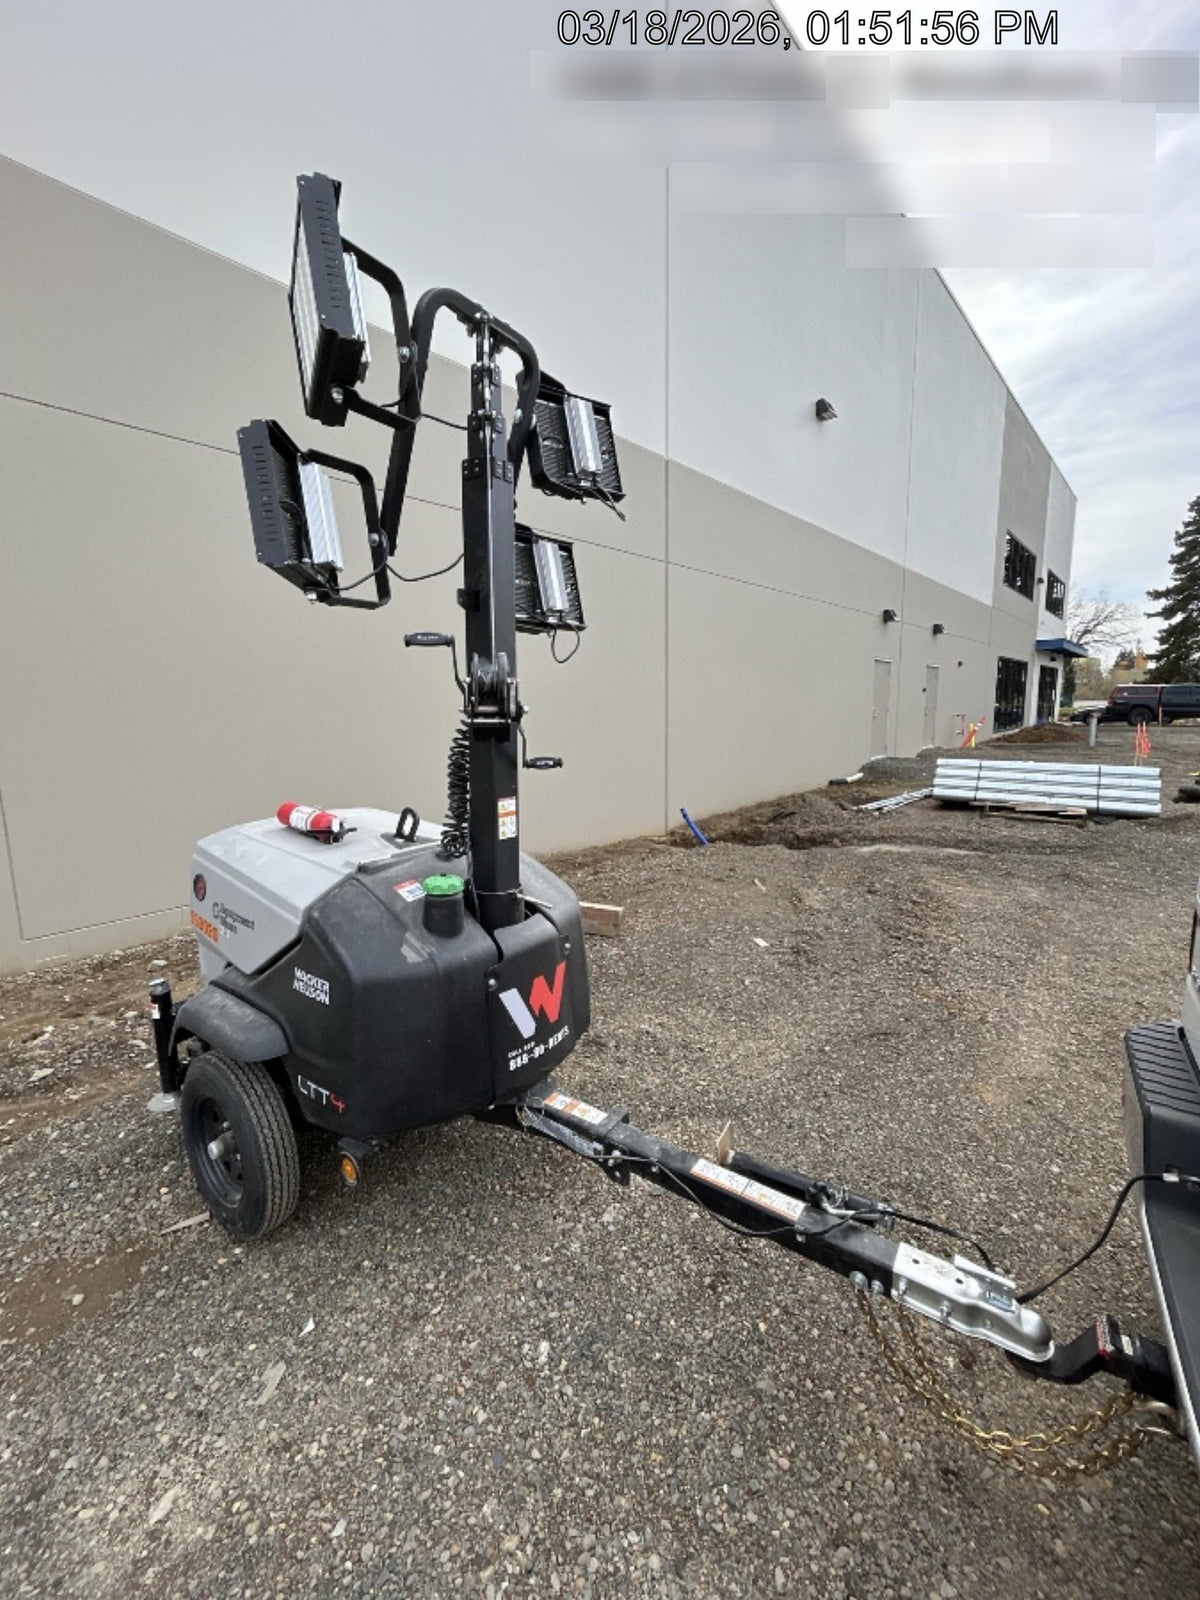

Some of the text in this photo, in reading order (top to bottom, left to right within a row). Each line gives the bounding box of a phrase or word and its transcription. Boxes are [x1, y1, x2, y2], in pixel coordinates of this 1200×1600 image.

[292, 979, 330, 1006] NEUSON
[293, 966, 330, 993] WACKER
[297, 1074, 346, 1114] LTT4
